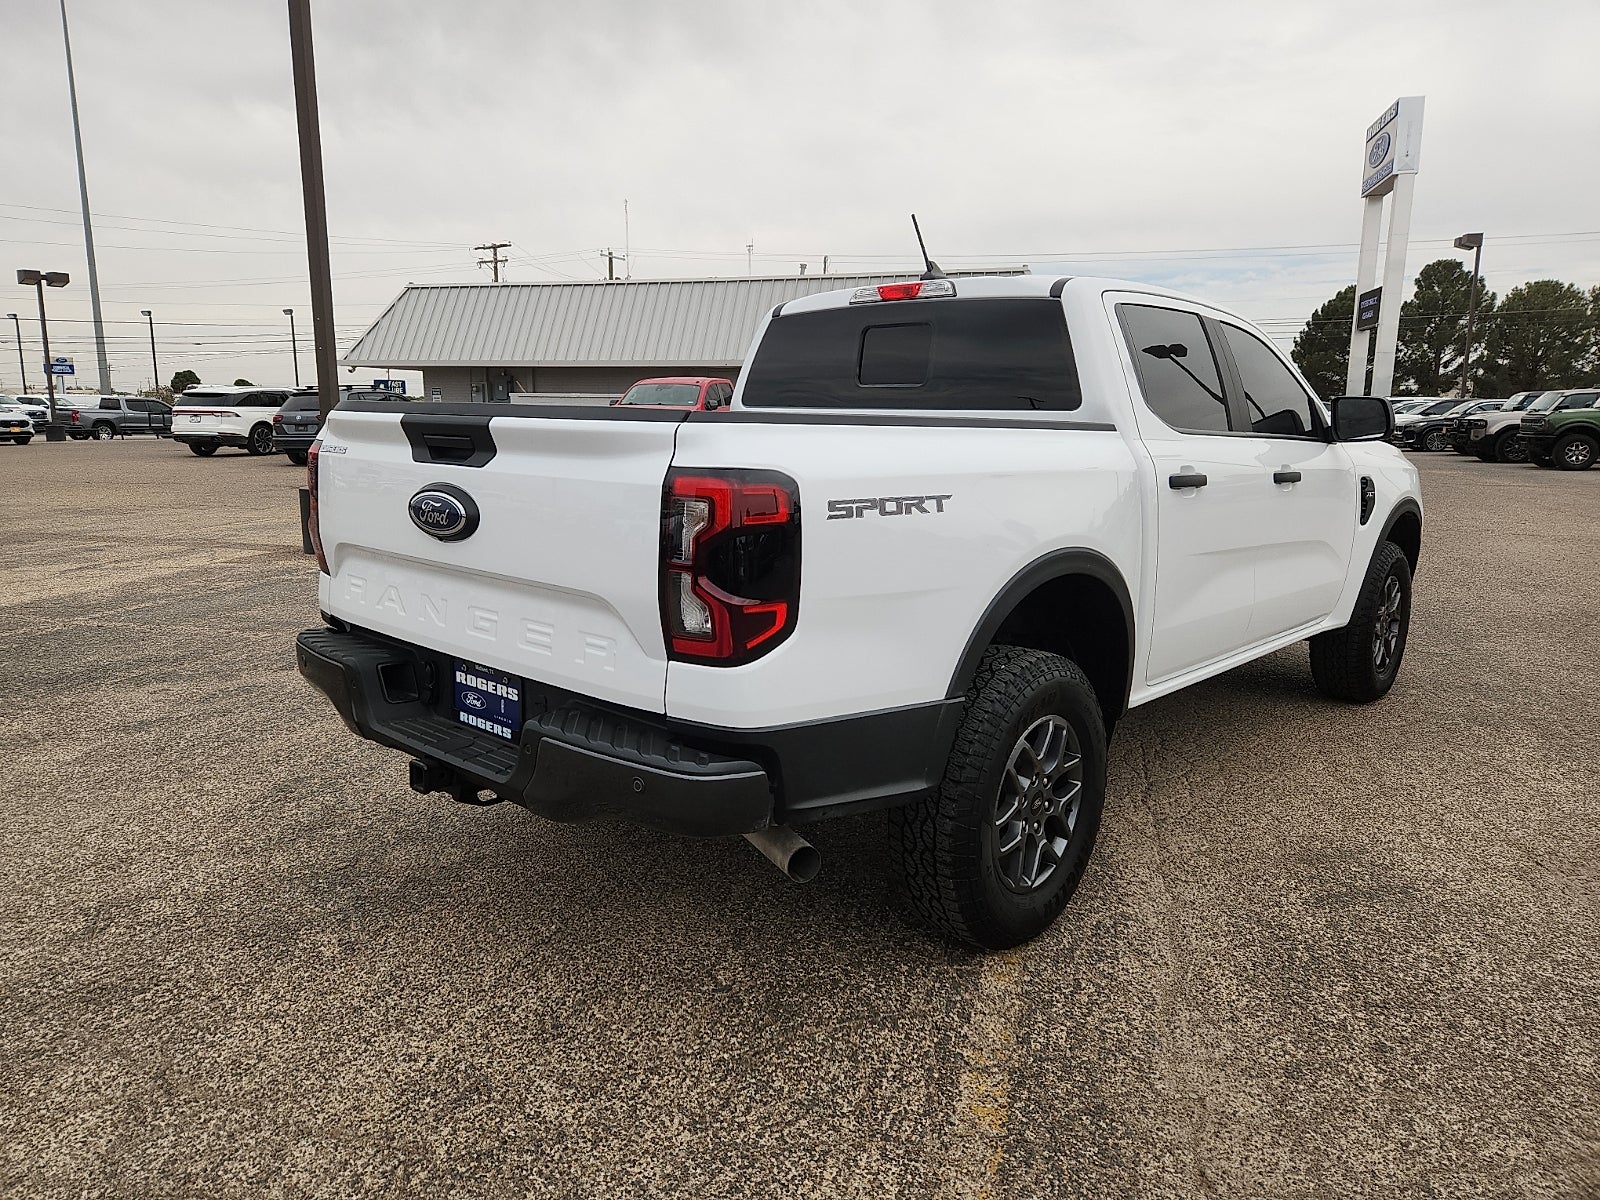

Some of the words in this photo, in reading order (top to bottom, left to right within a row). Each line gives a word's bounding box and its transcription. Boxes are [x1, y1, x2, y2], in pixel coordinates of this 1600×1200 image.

[420, 500, 449, 525] Ford
[827, 495, 952, 520] SPORT
[344, 574, 616, 672] RANGER
[455, 671, 519, 701] ROGERS
[465, 693, 482, 707] Ford
[460, 711, 512, 739] ROGERS
